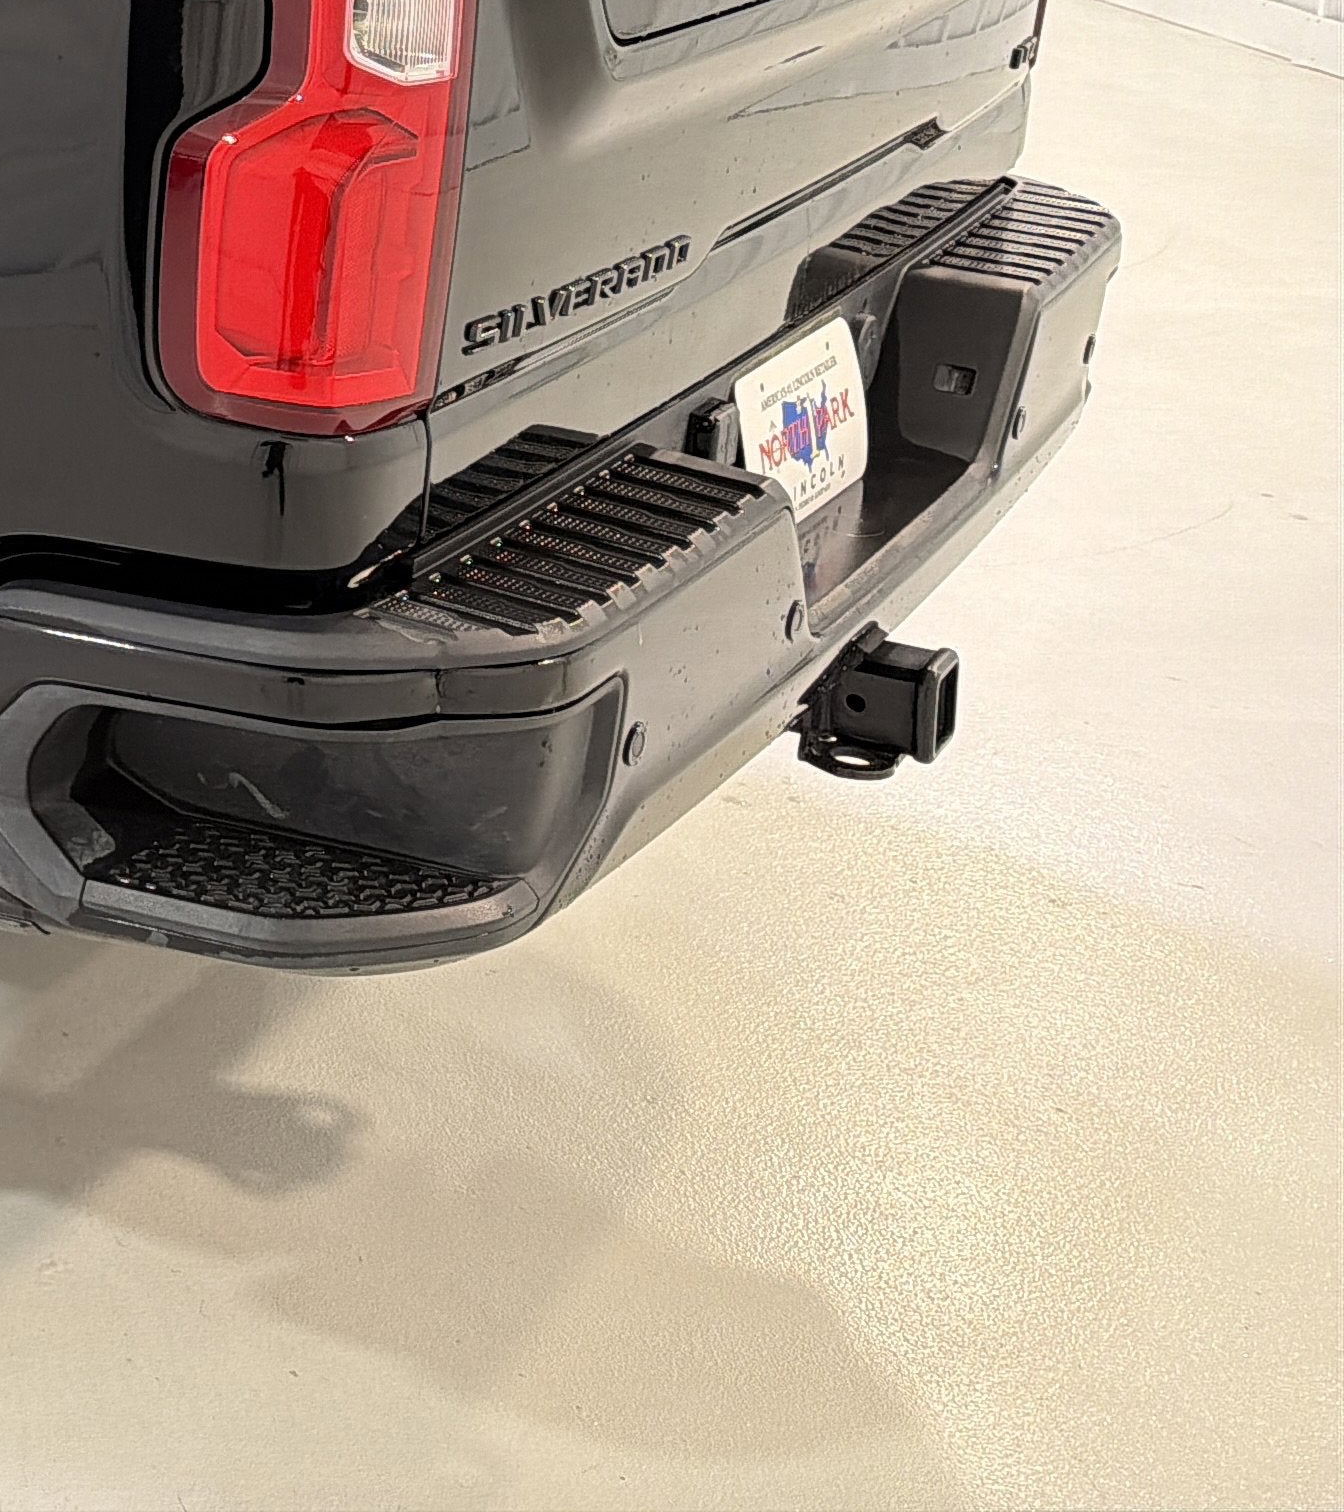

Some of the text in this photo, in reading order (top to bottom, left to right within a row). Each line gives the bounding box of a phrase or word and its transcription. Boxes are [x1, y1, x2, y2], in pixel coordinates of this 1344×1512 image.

[462, 234, 692, 356] SILVERADO
[759, 388, 854, 474] NORTH PARK
[793, 453, 844, 501] INCOLN
